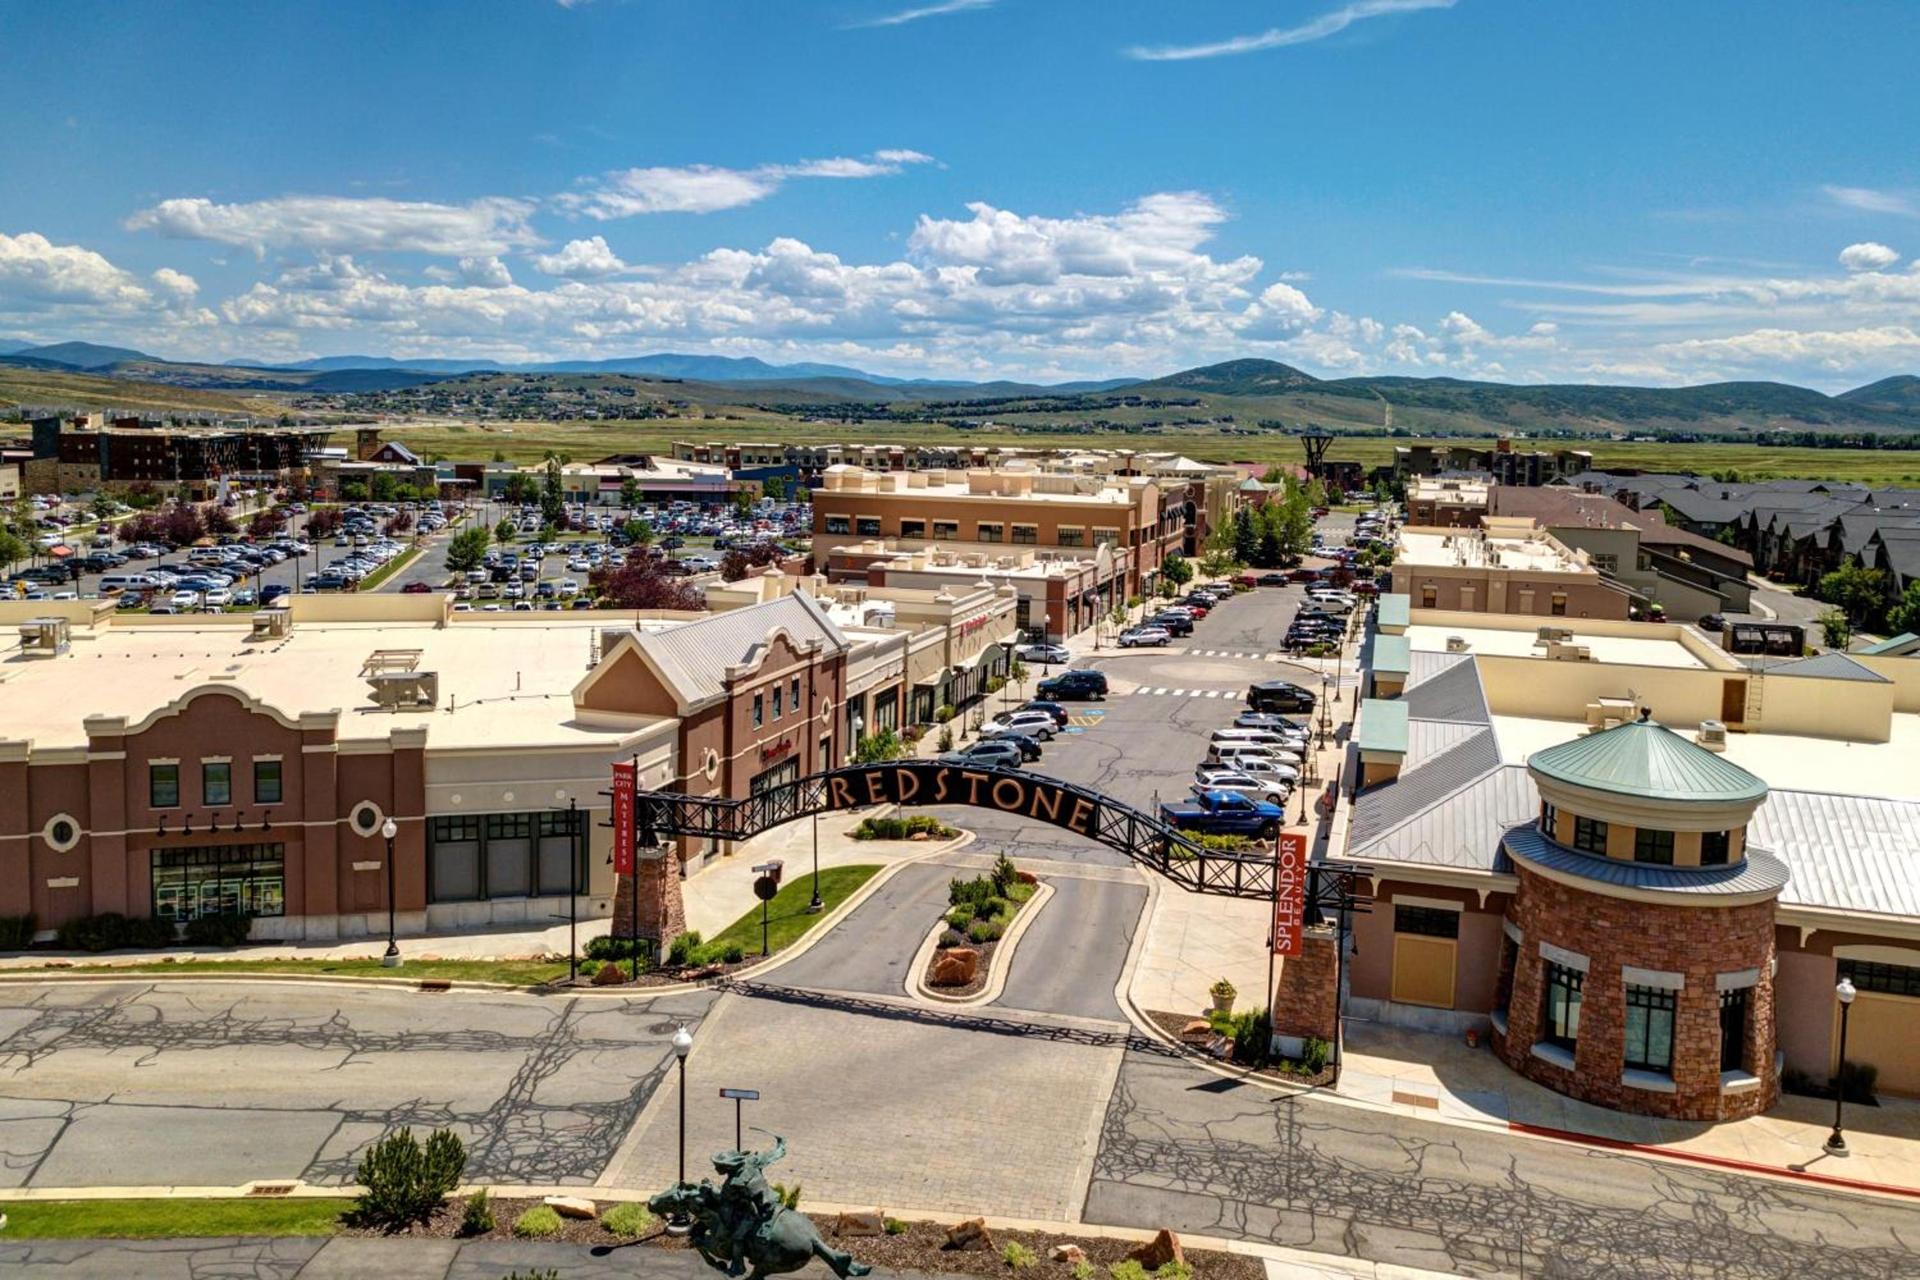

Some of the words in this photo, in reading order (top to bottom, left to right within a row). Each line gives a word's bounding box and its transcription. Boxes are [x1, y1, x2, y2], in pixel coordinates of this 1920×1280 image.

[615, 781, 632, 789] CITY
[829, 768, 1095, 834] REDSTONE
[620, 792, 629, 866] MATTRESS
[1277, 839, 1297, 951] SPLENDOR
[1293, 866, 1303, 926] BEAUTY
